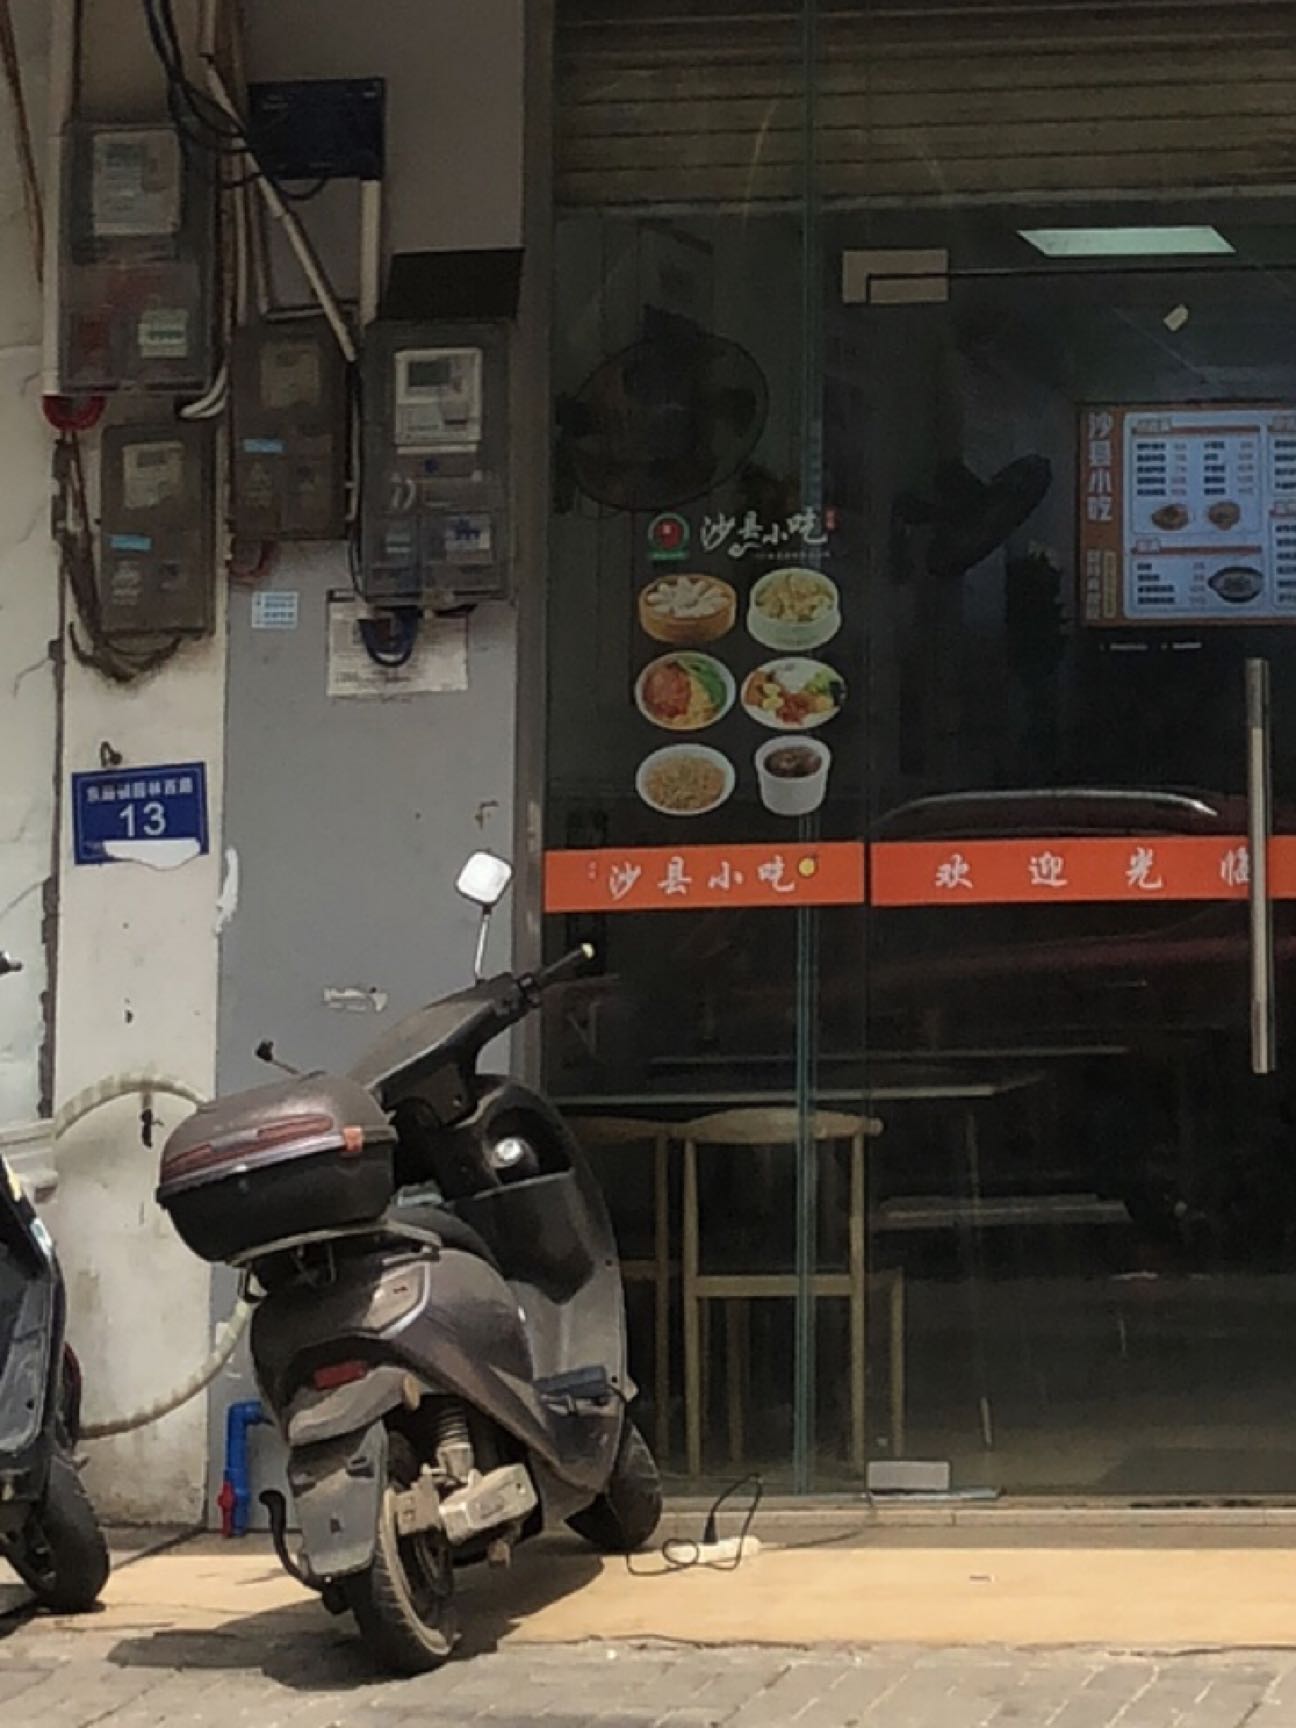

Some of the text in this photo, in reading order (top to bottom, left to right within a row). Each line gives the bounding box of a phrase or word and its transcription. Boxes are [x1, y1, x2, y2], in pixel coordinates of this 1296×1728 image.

[701, 506, 828, 556] 沙县小吃
[119, 802, 166, 837] 13
[609, 855, 795, 900] 沙县小吃
